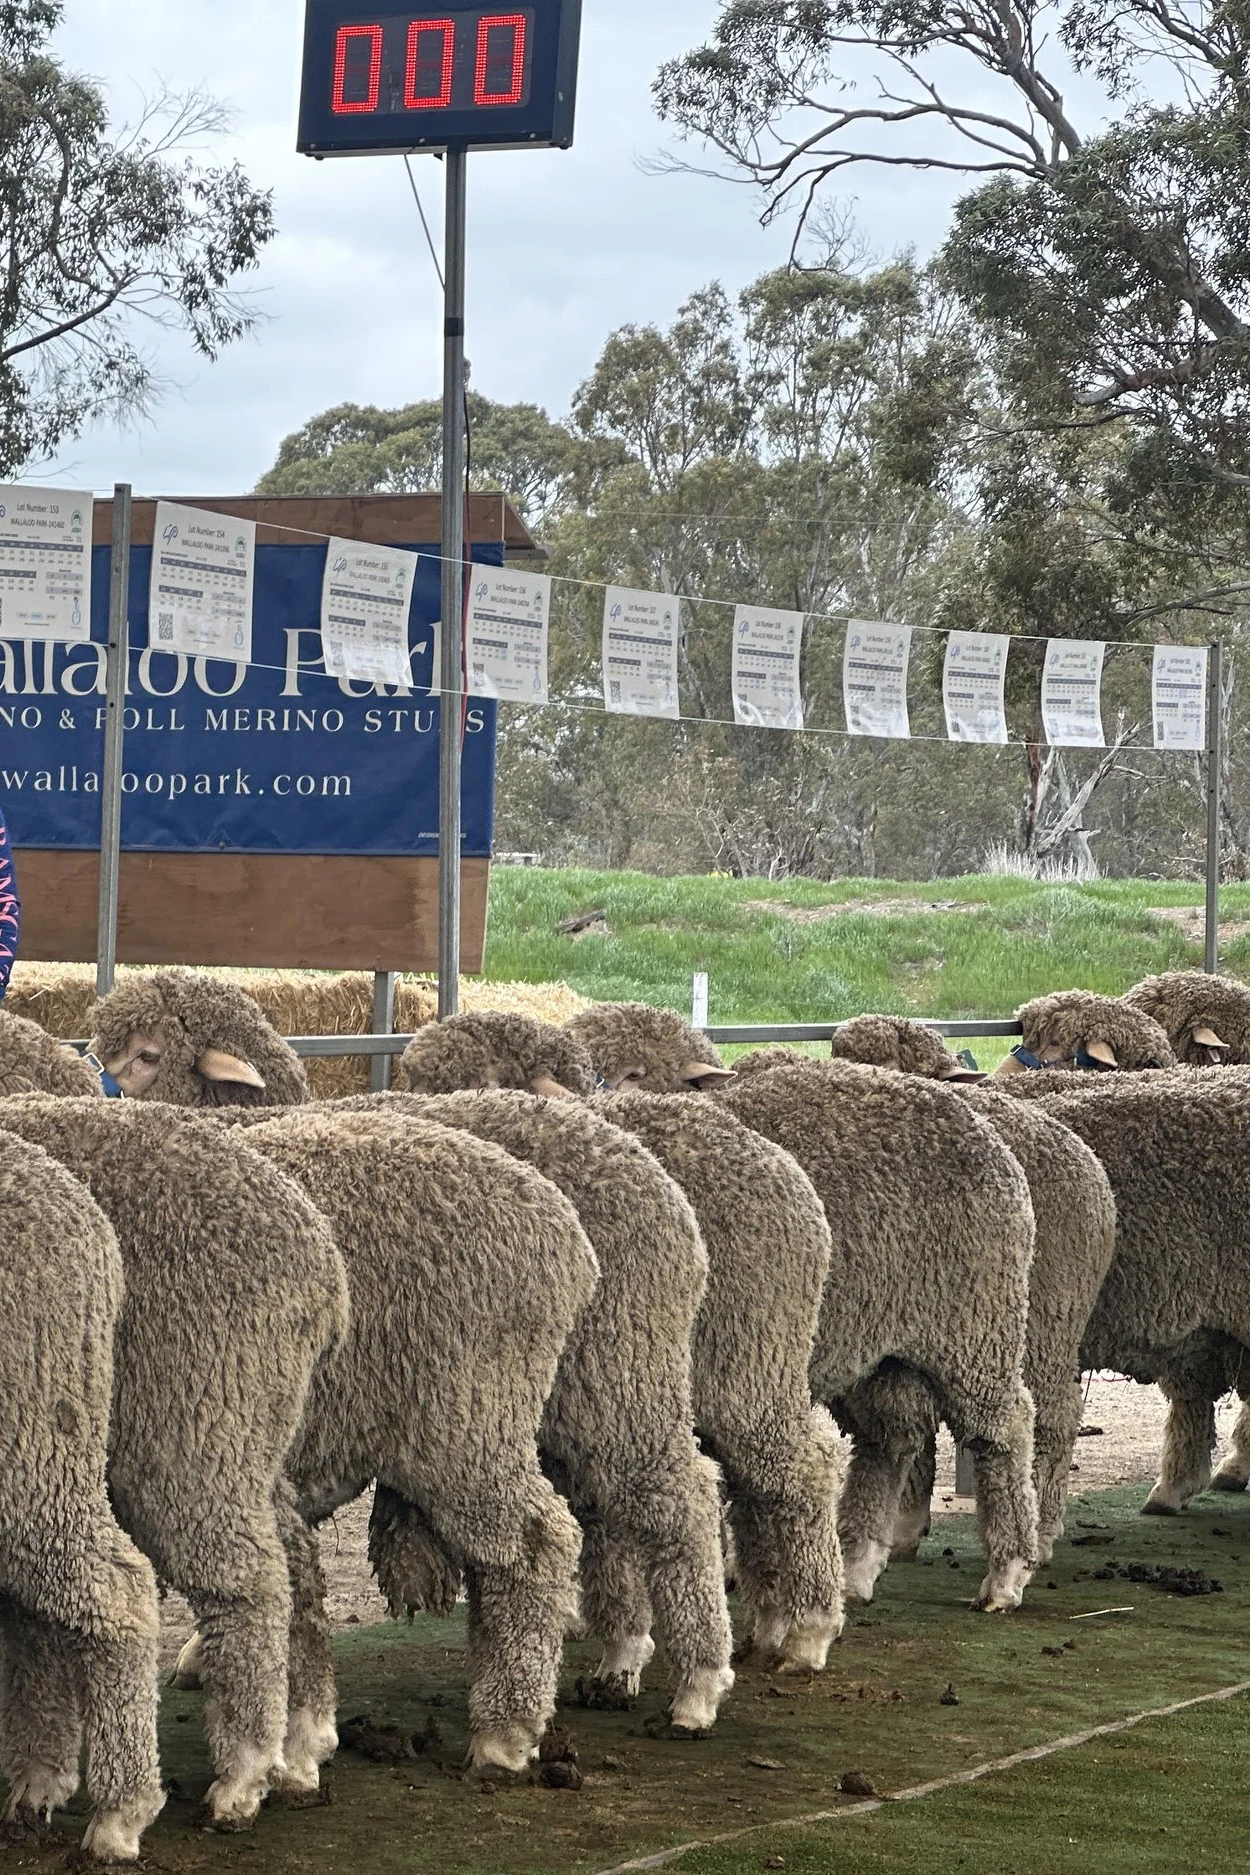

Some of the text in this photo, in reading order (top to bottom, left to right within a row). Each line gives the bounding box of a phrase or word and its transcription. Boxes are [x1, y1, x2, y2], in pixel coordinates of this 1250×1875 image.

[16, 503, 26, 512] Lot
[50, 505, 60, 514] 153
[188, 525, 196, 533] Lot
[59, 708, 76, 730] &
[204, 708, 345, 733] MERINO
[363, 709, 485, 733] STUS
